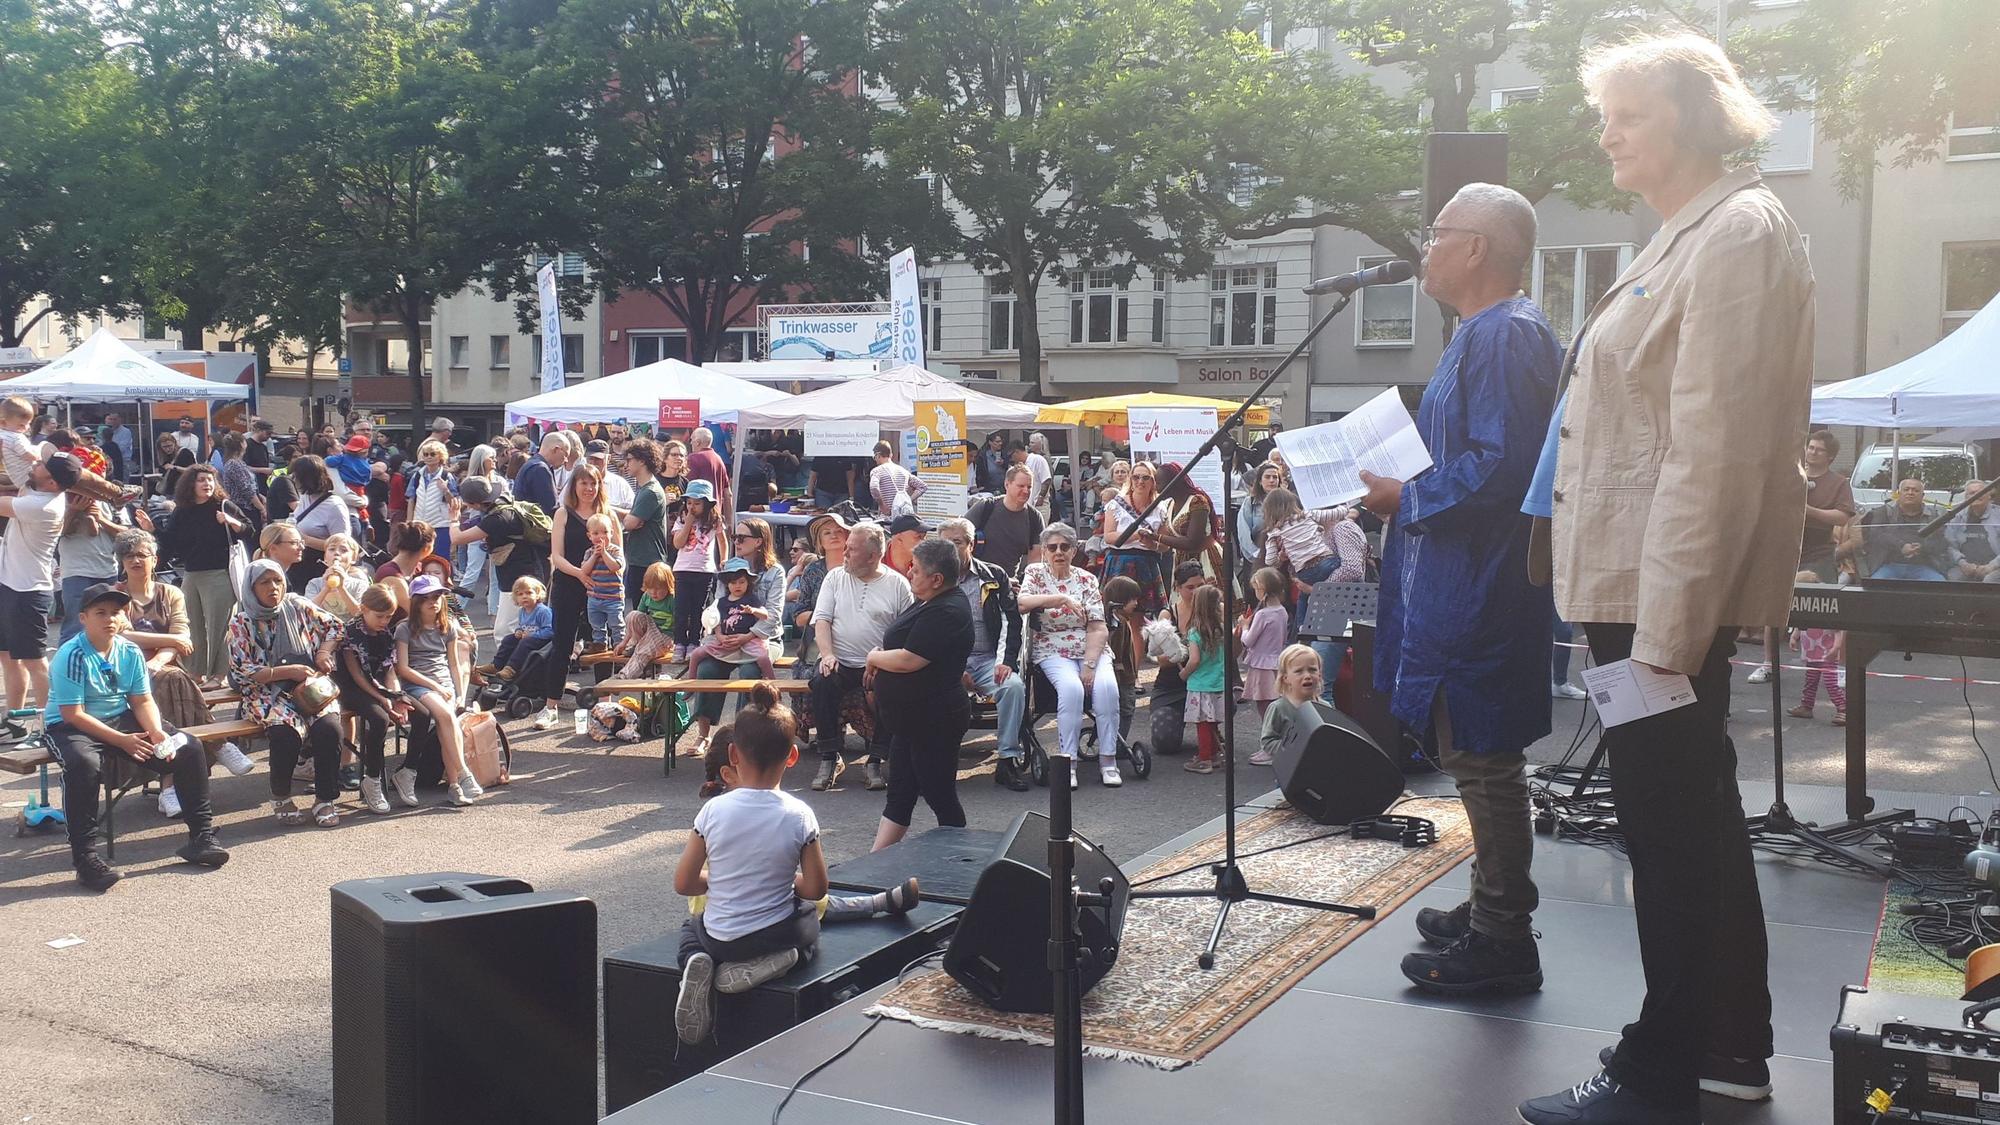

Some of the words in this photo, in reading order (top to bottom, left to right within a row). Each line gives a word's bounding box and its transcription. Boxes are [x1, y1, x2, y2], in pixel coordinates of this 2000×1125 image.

[779, 320, 858, 334] Trinkwasser
[1199, 367, 1242, 381] Salon
[194, 388, 209, 396] und
[1246, 412, 1264, 420] Köln
[1790, 596, 1839, 614] AMAHA
